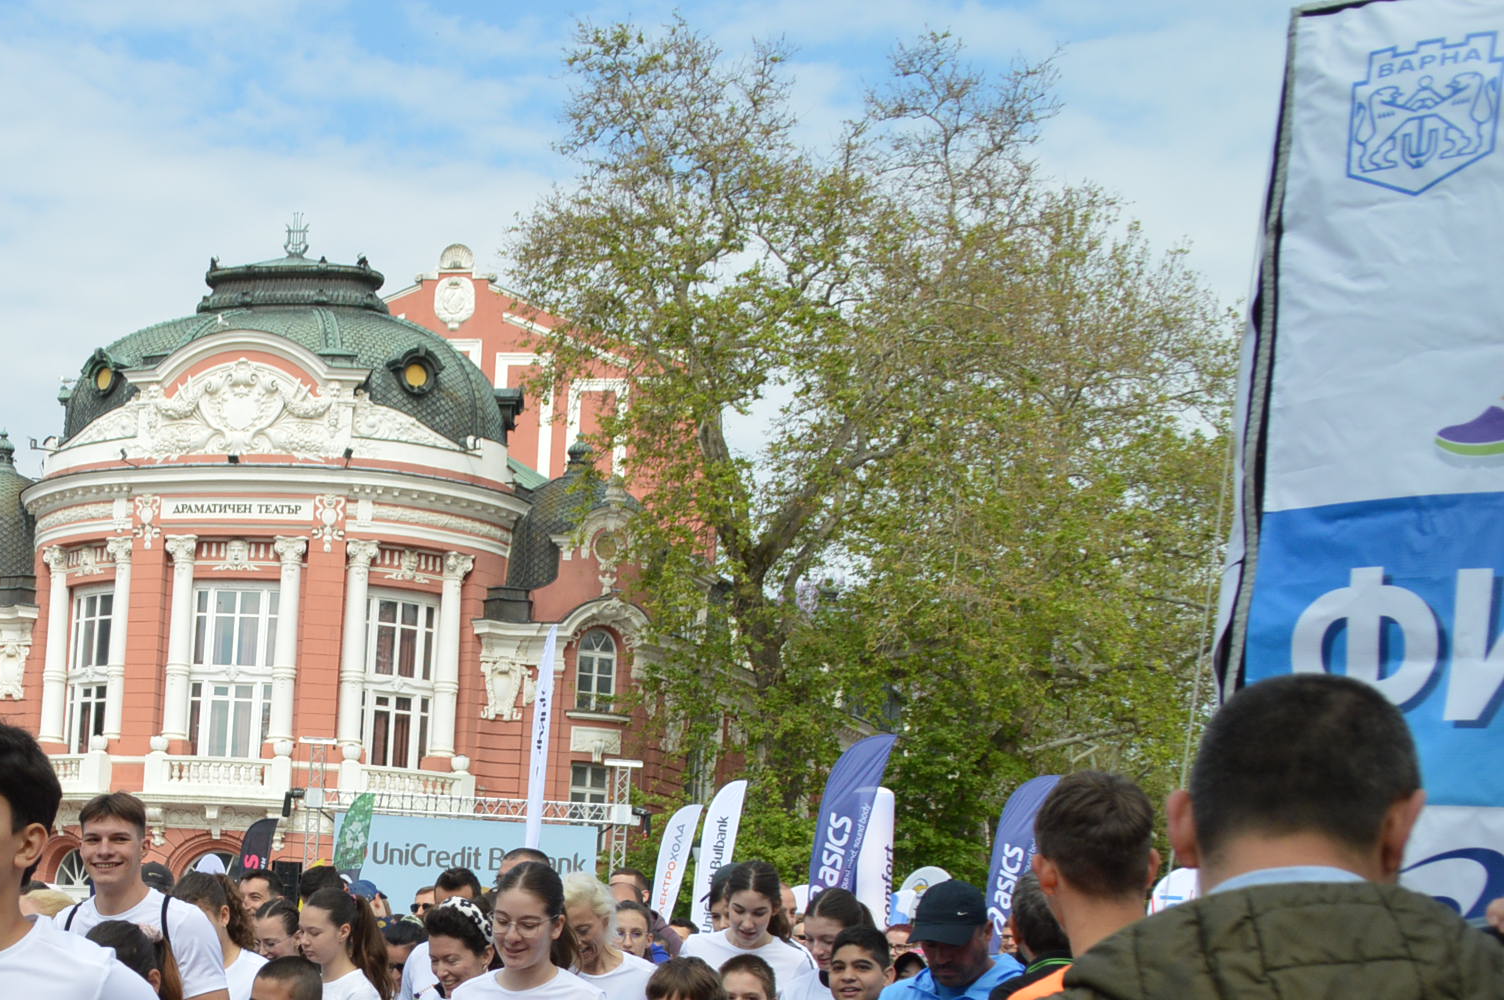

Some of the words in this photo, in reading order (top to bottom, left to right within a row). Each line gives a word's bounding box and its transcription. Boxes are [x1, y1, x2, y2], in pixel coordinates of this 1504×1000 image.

[1376, 48, 1482, 78] ВАРНА
[172, 503, 253, 514] ДРАМАТИЧЕН
[257, 503, 302, 515] ТЕАТЪР
[372, 841, 482, 871] UniCredit
[709, 816, 729, 869] Bulbank
[658, 823, 686, 915] ЛЕКТРОХОЛД
